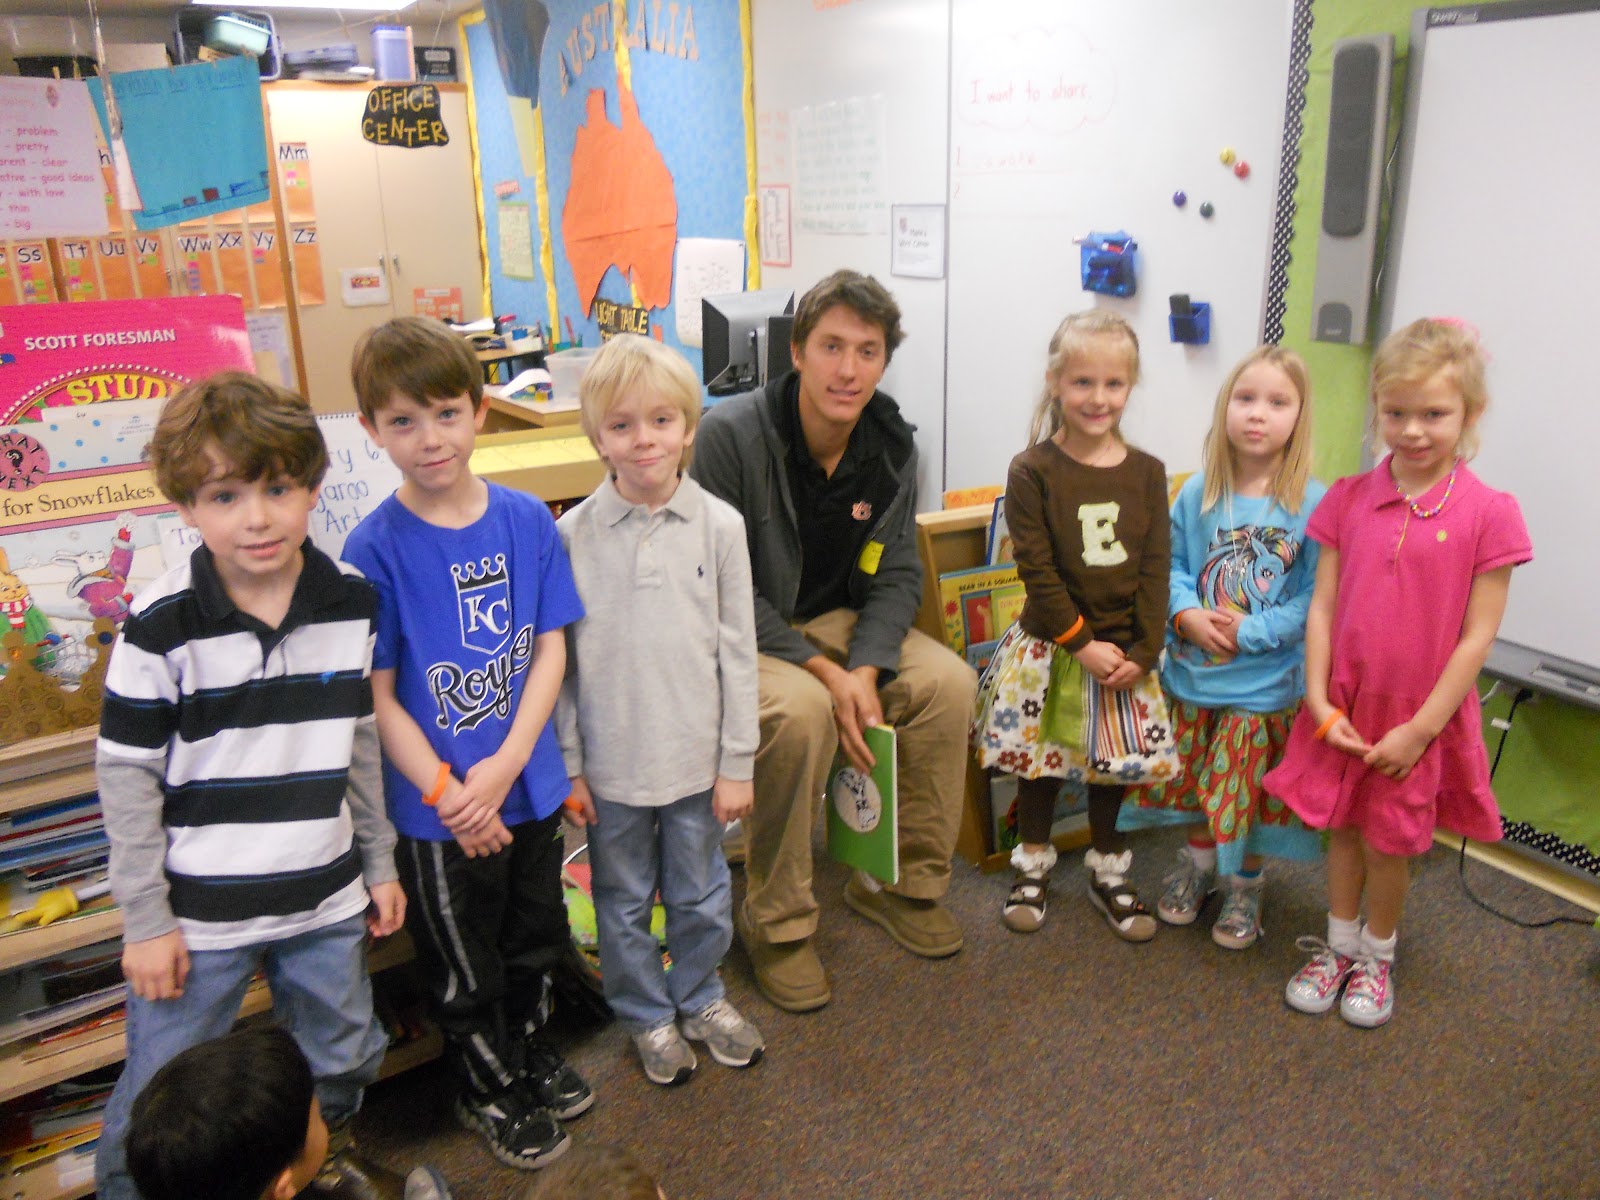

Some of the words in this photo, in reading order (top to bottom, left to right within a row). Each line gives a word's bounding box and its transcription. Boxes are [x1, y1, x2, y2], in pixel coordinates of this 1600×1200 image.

[368, 85, 434, 113] OFFICE
[971, 79, 981, 104] I
[987, 80, 1014, 104] want
[1024, 79, 1041, 102] to
[17, 126, 58, 137] problem
[363, 116, 448, 147] CENTER
[16, 143, 49, 152] pretty
[279, 145, 309, 161] Mm
[42, 158, 68, 167] clear
[41, 173, 65, 185] good
[69, 172, 95, 182] ideas
[19, 188, 40, 197] with
[45, 188, 65, 197] love
[9, 203, 30, 213] thin
[15, 218, 31, 231] big
[18, 247, 42, 263] Ss
[65, 243, 87, 259] Tt
[100, 241, 125, 256] Uu
[136, 238, 158, 253] Vv
[180, 237, 212, 252] Ww
[218, 233, 242, 248] Xx
[253, 231, 274, 250] Yy
[294, 228, 316, 243] Zz
[621, 309, 648, 335] TABLE
[24, 335, 77, 351] SCOTT
[83, 329, 177, 347] FORESMAN
[3, 498, 33, 517] for
[38, 483, 155, 512] Snowflakes
[1077, 500, 1128, 567] E
[987, 579, 993, 587] A
[994, 575, 1021, 585] SQUAR
[464, 593, 510, 635] KC
